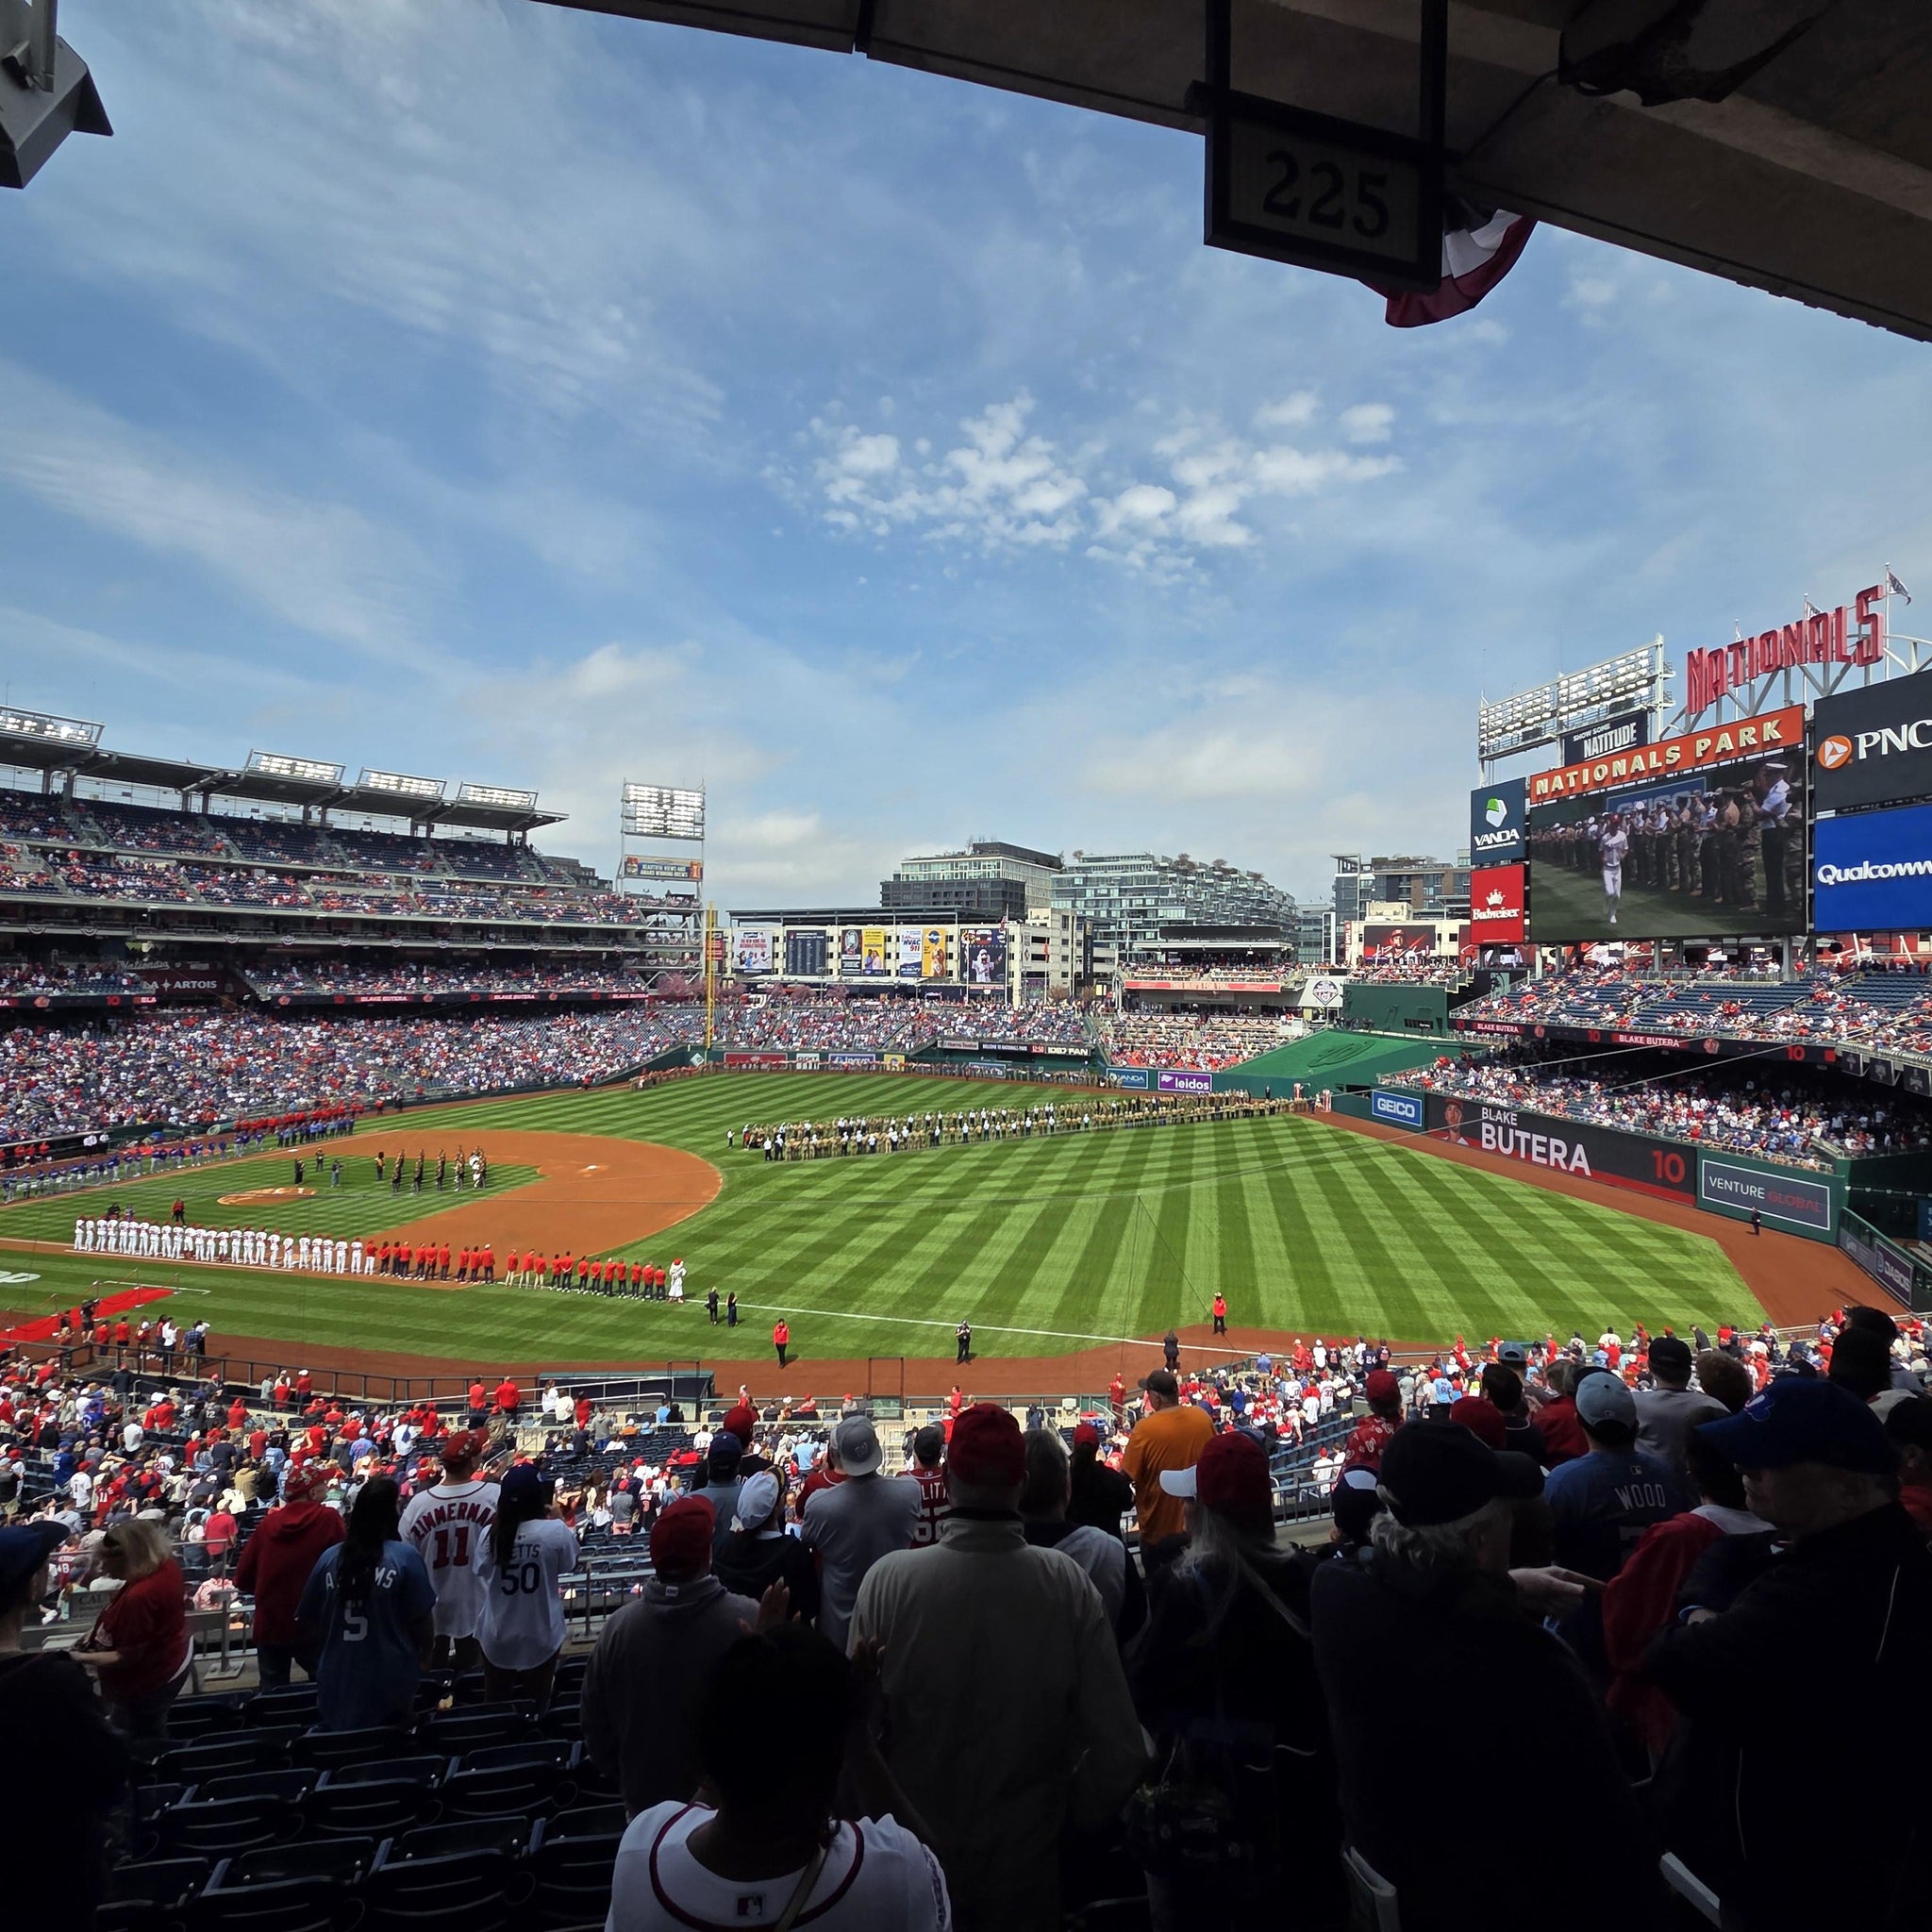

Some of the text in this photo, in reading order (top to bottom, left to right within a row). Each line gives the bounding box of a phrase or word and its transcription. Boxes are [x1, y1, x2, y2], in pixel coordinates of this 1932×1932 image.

[1262, 149, 1391, 238] 225
[1687, 584, 1885, 715] NATIONALS
[1573, 730, 1592, 741] SHOW
[1584, 722, 1637, 758] NATITUDE
[1854, 719, 1932, 760] PNC
[1536, 719, 1783, 796] NATIONALS PARK
[1474, 828, 1520, 846] VANDA
[1473, 907, 1520, 921] Budweiser
[1477, 1023, 1495, 1031] BLAKE
[1619, 1034, 1679, 1048] BLAKE BUTERA
[1068, 1047, 1089, 1056] FAN
[1786, 1045, 1805, 1061] 10
[1175, 1077, 1209, 1090] leidos
[1377, 1097, 1415, 1118] GEICO
[1481, 1107, 1518, 1126] BLAKE
[1481, 1122, 1591, 1176] BUTERA
[1652, 1149, 1686, 1184] 10
[1708, 1175, 1822, 1213] VENTURE GLOBAL
[99, 1491, 108, 1502] 11
[1614, 1483, 1666, 1511] WOOD
[433, 1526, 470, 1570] 11
[501, 1562, 541, 1595] 50
[343, 1600, 368, 1641] 5
